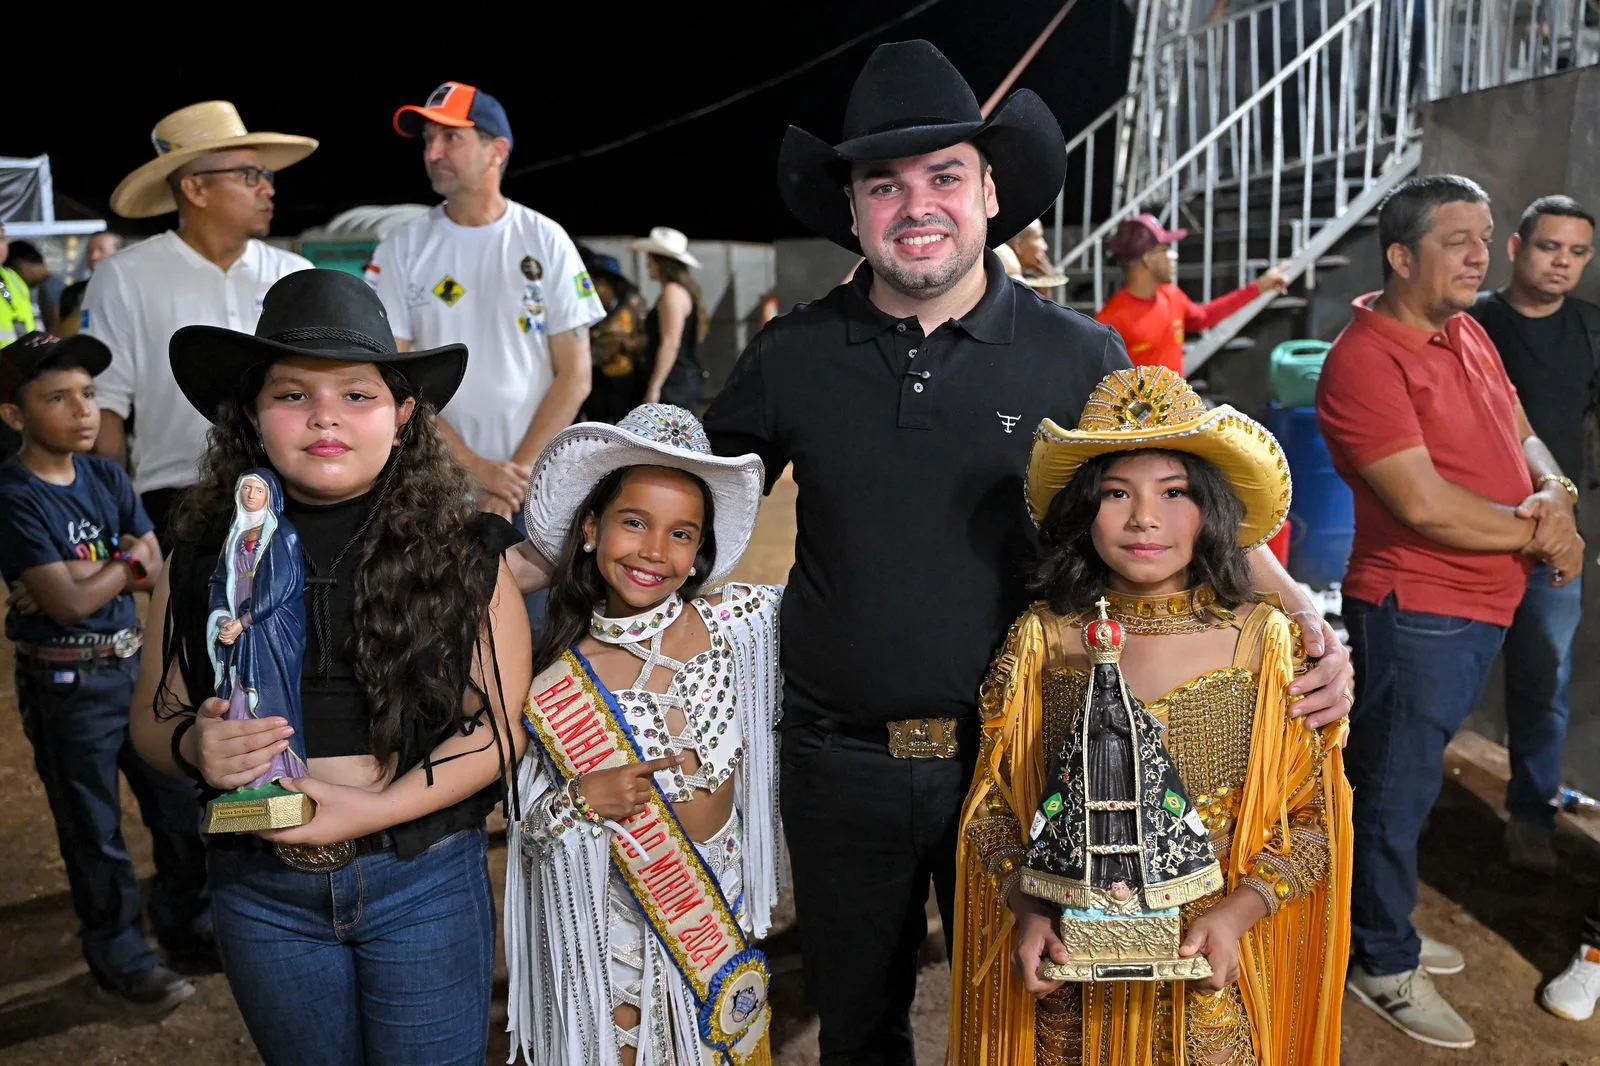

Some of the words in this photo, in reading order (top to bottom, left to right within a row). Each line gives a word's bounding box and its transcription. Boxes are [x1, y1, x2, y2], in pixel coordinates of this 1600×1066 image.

[533, 674, 616, 776] RAINHA
[637, 849, 705, 925] MIRIM
[678, 913, 729, 971] 2024
